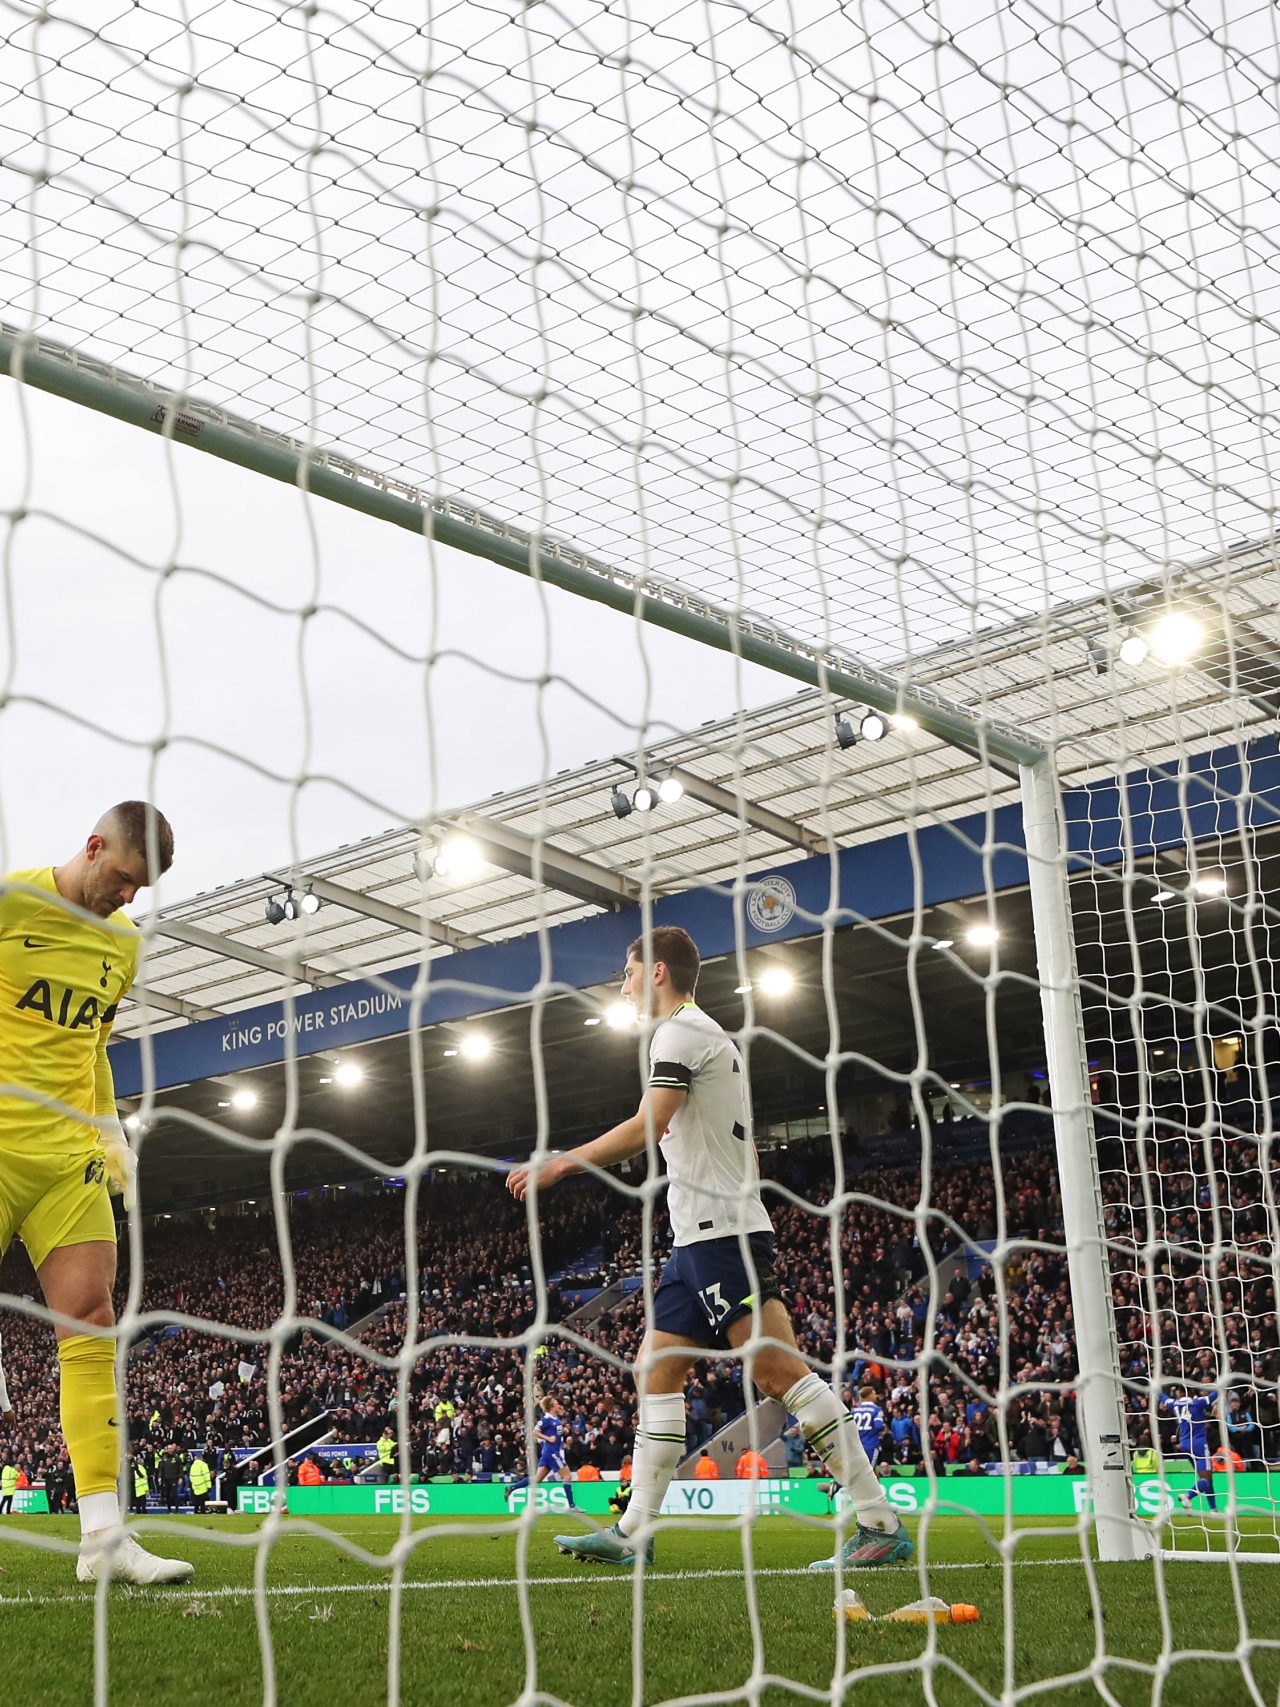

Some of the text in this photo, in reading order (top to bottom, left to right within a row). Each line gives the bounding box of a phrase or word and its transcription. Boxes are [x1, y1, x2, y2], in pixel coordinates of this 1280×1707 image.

[15, 979, 99, 1030] AIA
[222, 991, 402, 1052] KING POWER STADIUM
[853, 1412, 873, 1431] 22
[721, 1440, 734, 1453] V4
[375, 1488, 430, 1513] FBS
[508, 1486, 570, 1513] FBS
[682, 1488, 714, 1510] YO
[1072, 1480, 1175, 1513] FS
